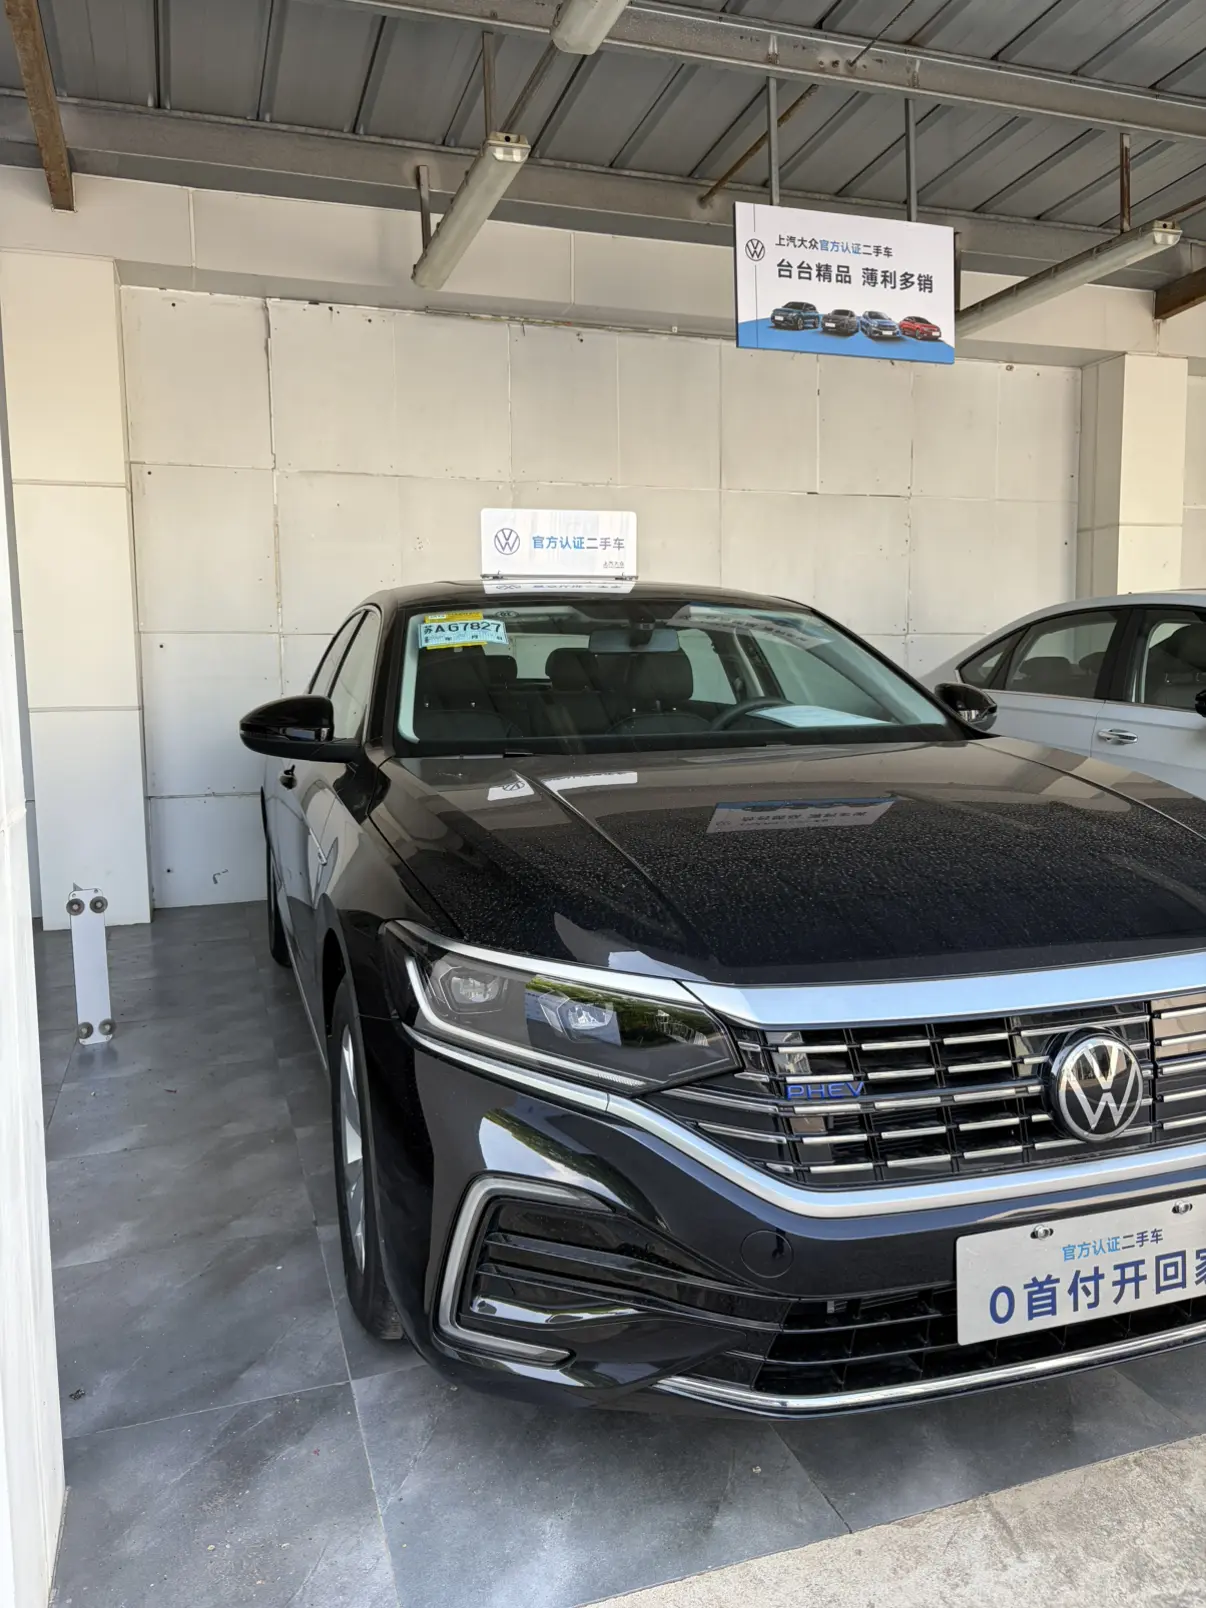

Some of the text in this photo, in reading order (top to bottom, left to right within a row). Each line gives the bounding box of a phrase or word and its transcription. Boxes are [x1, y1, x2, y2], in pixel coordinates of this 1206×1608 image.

[775, 234, 893, 258] 上汽大众官方认证二手车
[776, 258, 934, 294] 台台精品 薄利多销
[532, 535, 625, 551] 官方认证二手车
[785, 1080, 865, 1102] PHEV
[1062, 1228, 1164, 1263] 官方认证二手车
